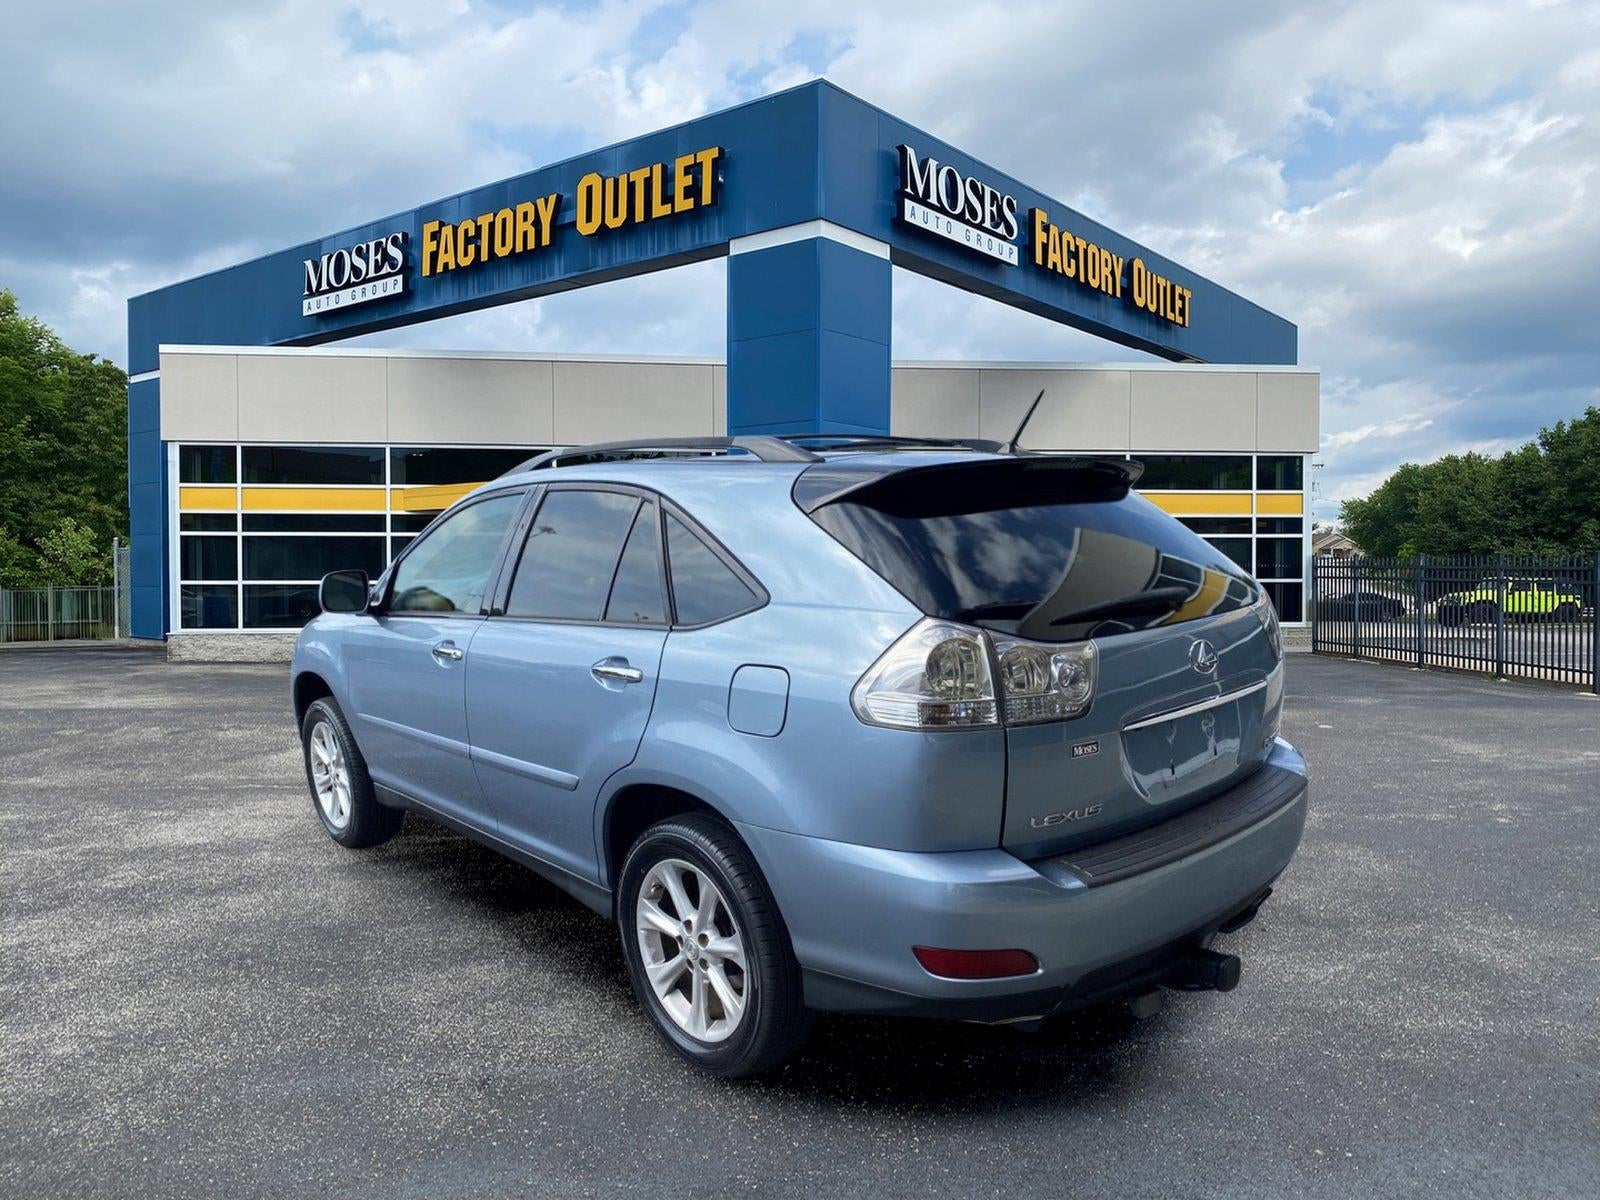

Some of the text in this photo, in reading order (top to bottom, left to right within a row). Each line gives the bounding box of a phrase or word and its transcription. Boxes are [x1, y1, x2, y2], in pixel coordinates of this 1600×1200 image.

[422, 146, 721, 277] FACTORY OUTLET
[903, 144, 1018, 240] MOSES
[303, 232, 403, 295] MOSES
[910, 206, 1014, 259] AUTO GROUP
[307, 279, 399, 311] AUTO GROUP
[1034, 207, 1192, 327] FACTORY OUTLET
[1030, 803, 1103, 828] LEXUS
